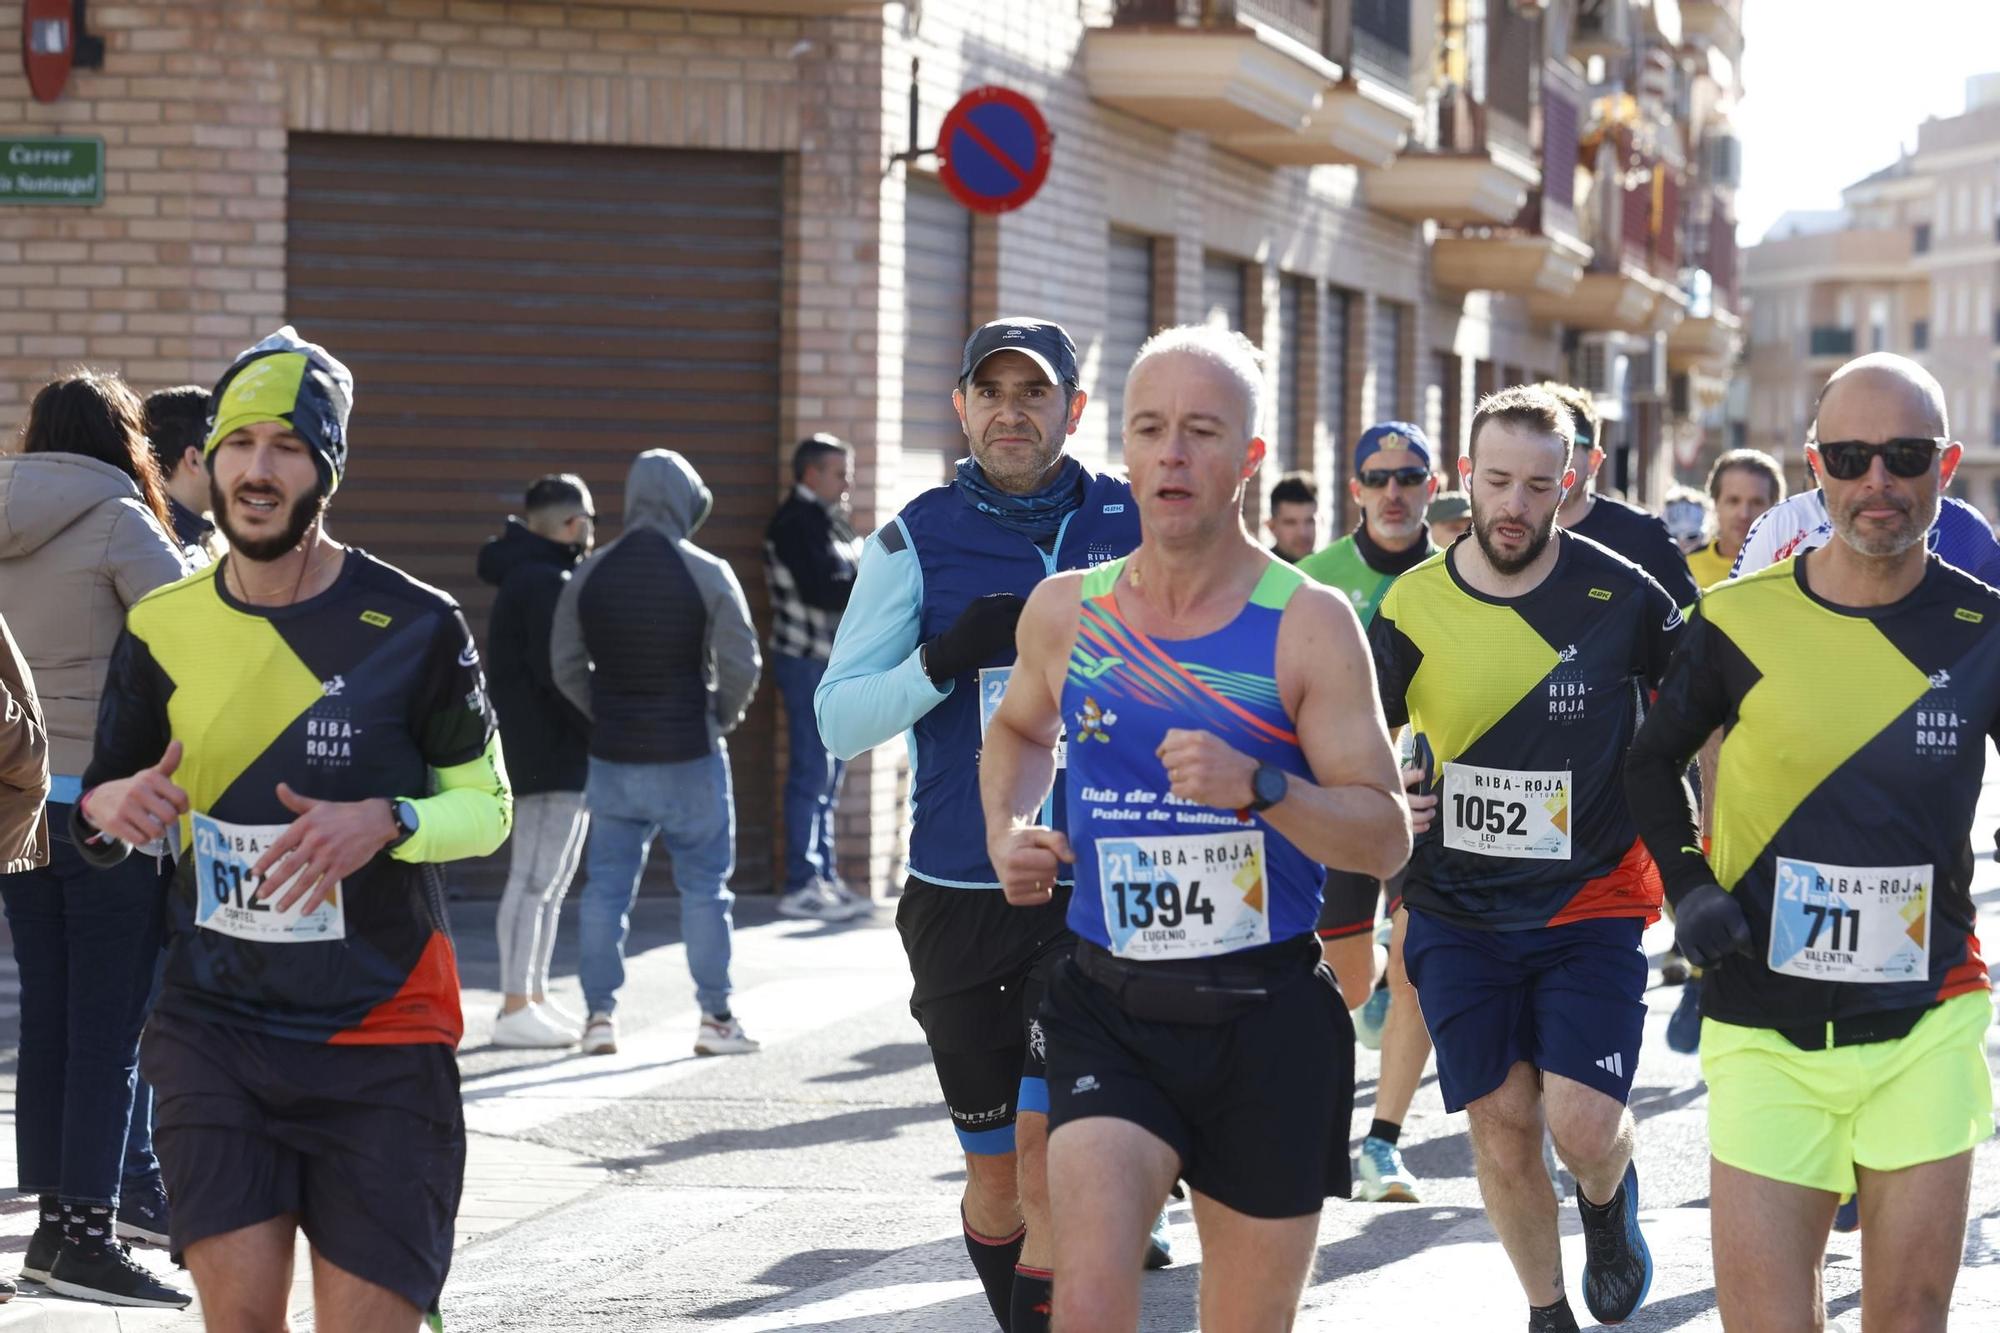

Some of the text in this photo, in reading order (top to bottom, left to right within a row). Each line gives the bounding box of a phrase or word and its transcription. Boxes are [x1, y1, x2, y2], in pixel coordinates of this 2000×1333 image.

[8, 143, 74, 166] Carrer
[1590, 589, 1611, 600] 42K
[1549, 683, 1593, 697] RIBA-
[1916, 711, 1968, 728] RIBA-
[307, 720, 362, 738] RIBA-
[1081, 787, 1119, 803] Club
[1125, 789, 1157, 804] de
[1092, 807, 1141, 820] Pobla
[1146, 809, 1171, 822] de
[1453, 793, 1528, 836] 1052
[197, 827, 217, 858] 21
[1481, 833, 1496, 843] LEO
[1108, 853, 1135, 881] 21
[213, 859, 270, 912] 612
[1783, 873, 1809, 904] 21
[1111, 880, 1215, 929] 1394
[1142, 929, 1187, 942] EUGENIO
[1803, 903, 1860, 952] 711
[1804, 950, 1853, 964] VALENTIN
